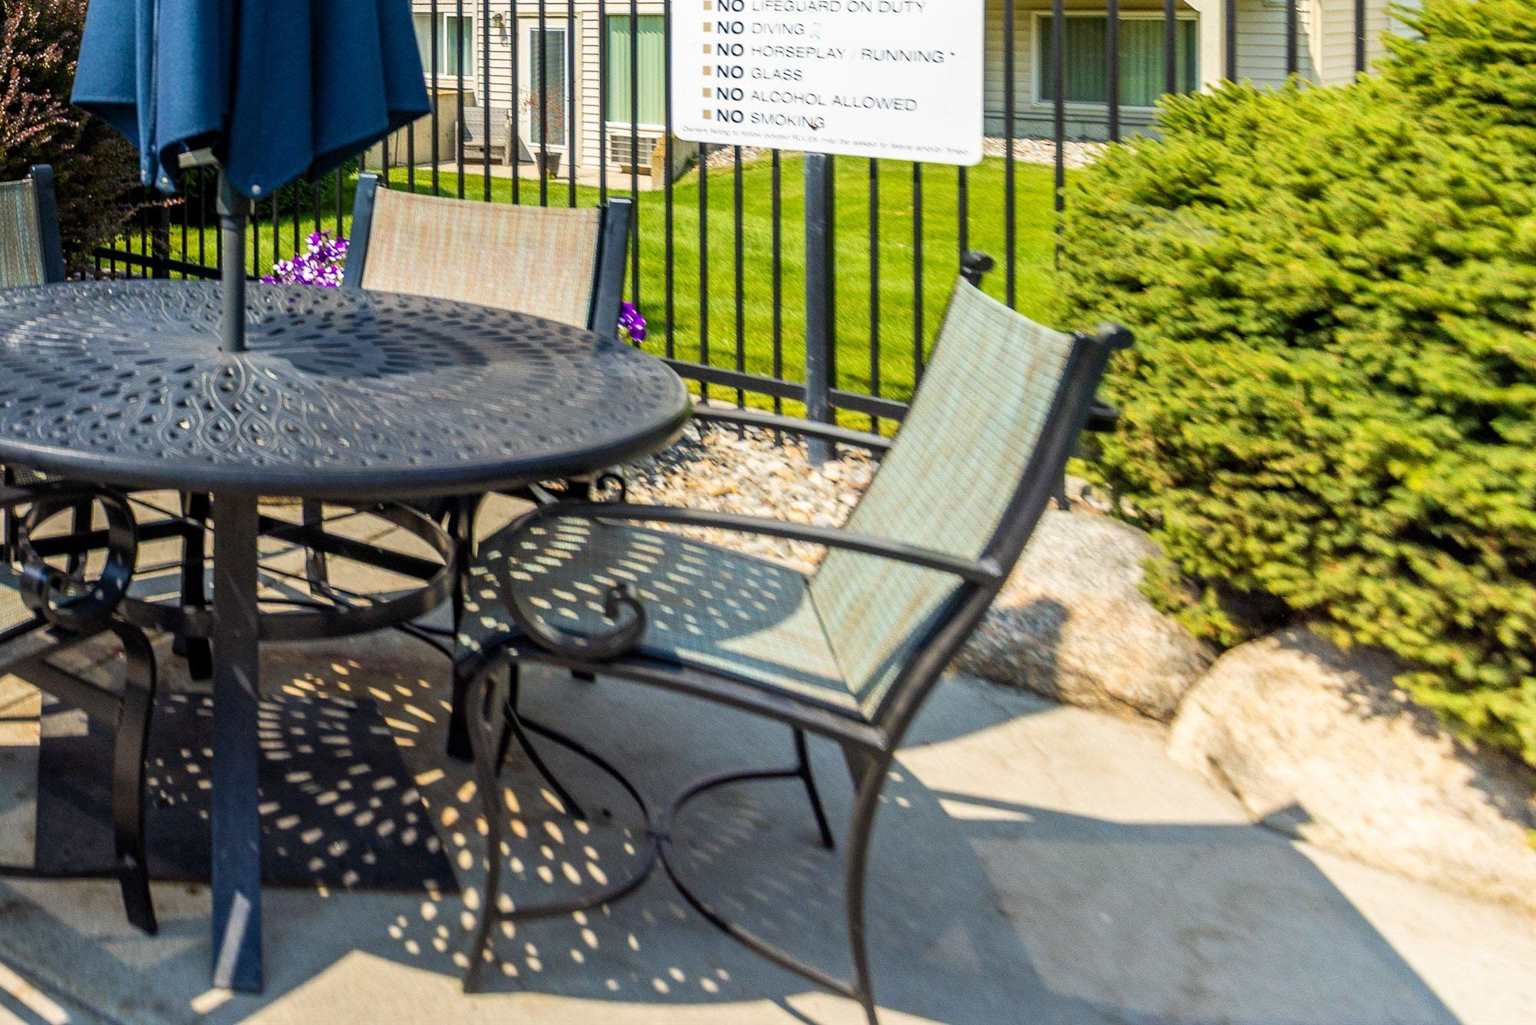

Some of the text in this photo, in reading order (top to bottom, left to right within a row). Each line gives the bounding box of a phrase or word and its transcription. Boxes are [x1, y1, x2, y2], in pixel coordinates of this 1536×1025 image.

[751, 0, 842, 14] LIFEGUARD
[847, 0, 873, 14] ON
[878, 0, 927, 15] DUTY
[716, 20, 806, 35] NO DIVING
[716, 42, 945, 64] NO HORSEPLAY RUNNING
[716, 64, 804, 82] NO GLASS
[716, 86, 919, 112] NO ALCOHOL ALLOWED
[716, 108, 826, 129] NO SMOKING
